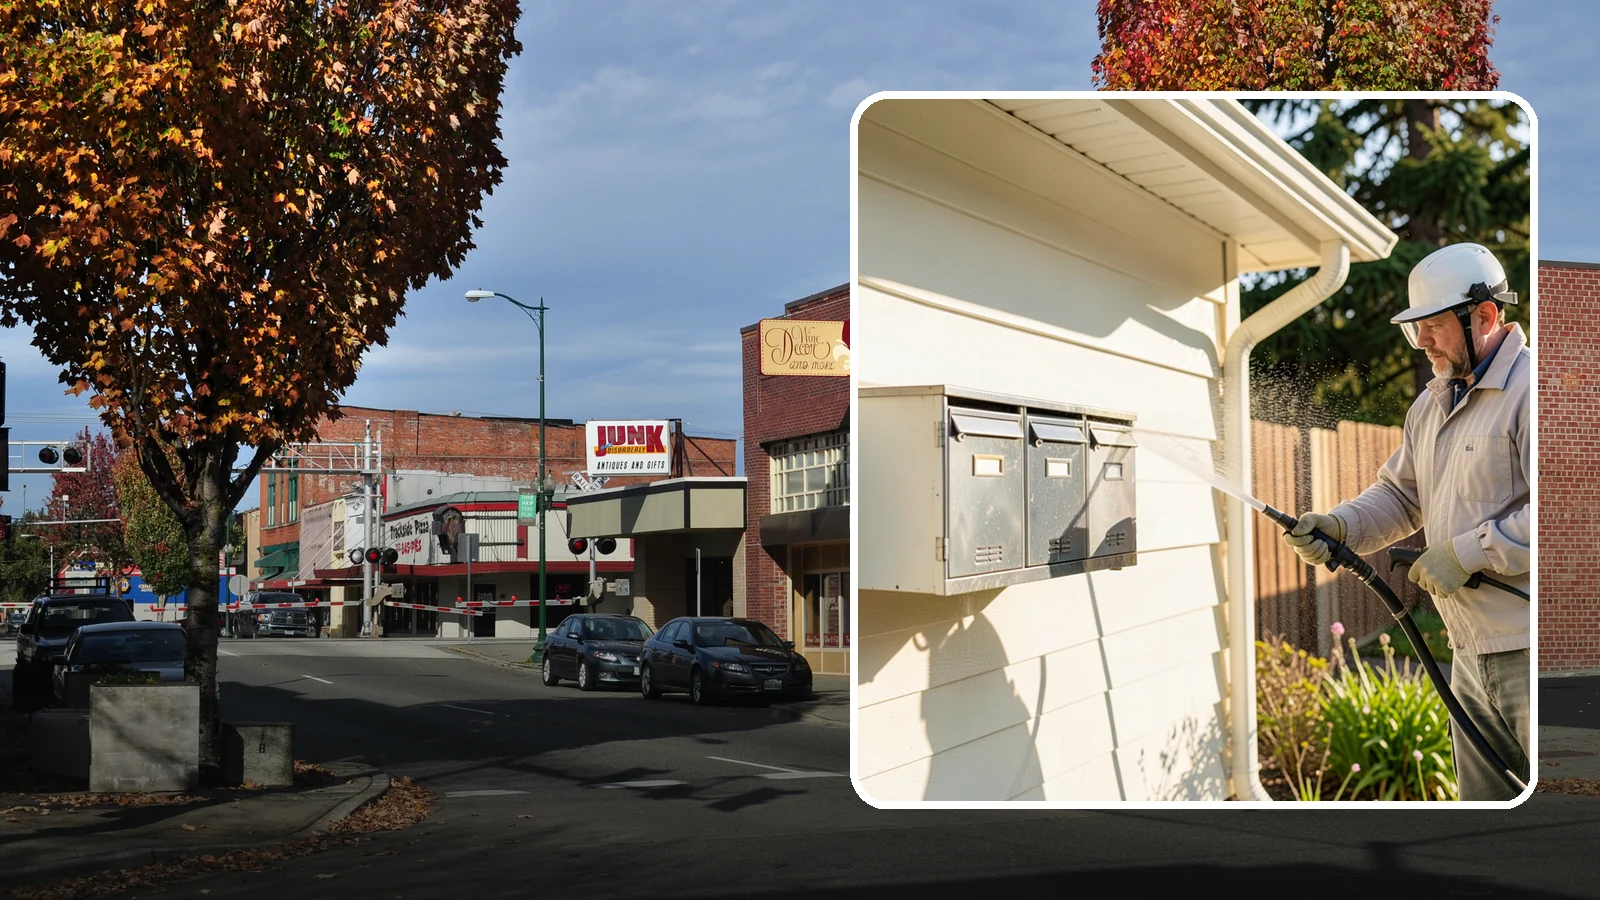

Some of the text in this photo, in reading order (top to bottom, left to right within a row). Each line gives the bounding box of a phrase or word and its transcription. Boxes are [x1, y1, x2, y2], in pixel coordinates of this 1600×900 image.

[595, 425, 665, 457] JUNK
[607, 446, 645, 454] DISORDERLY
[597, 460, 665, 470] ANTIQUES AND GIFTS
[573, 473, 588, 490] RAIL
[390, 519, 429, 540] Trackside Pizza
